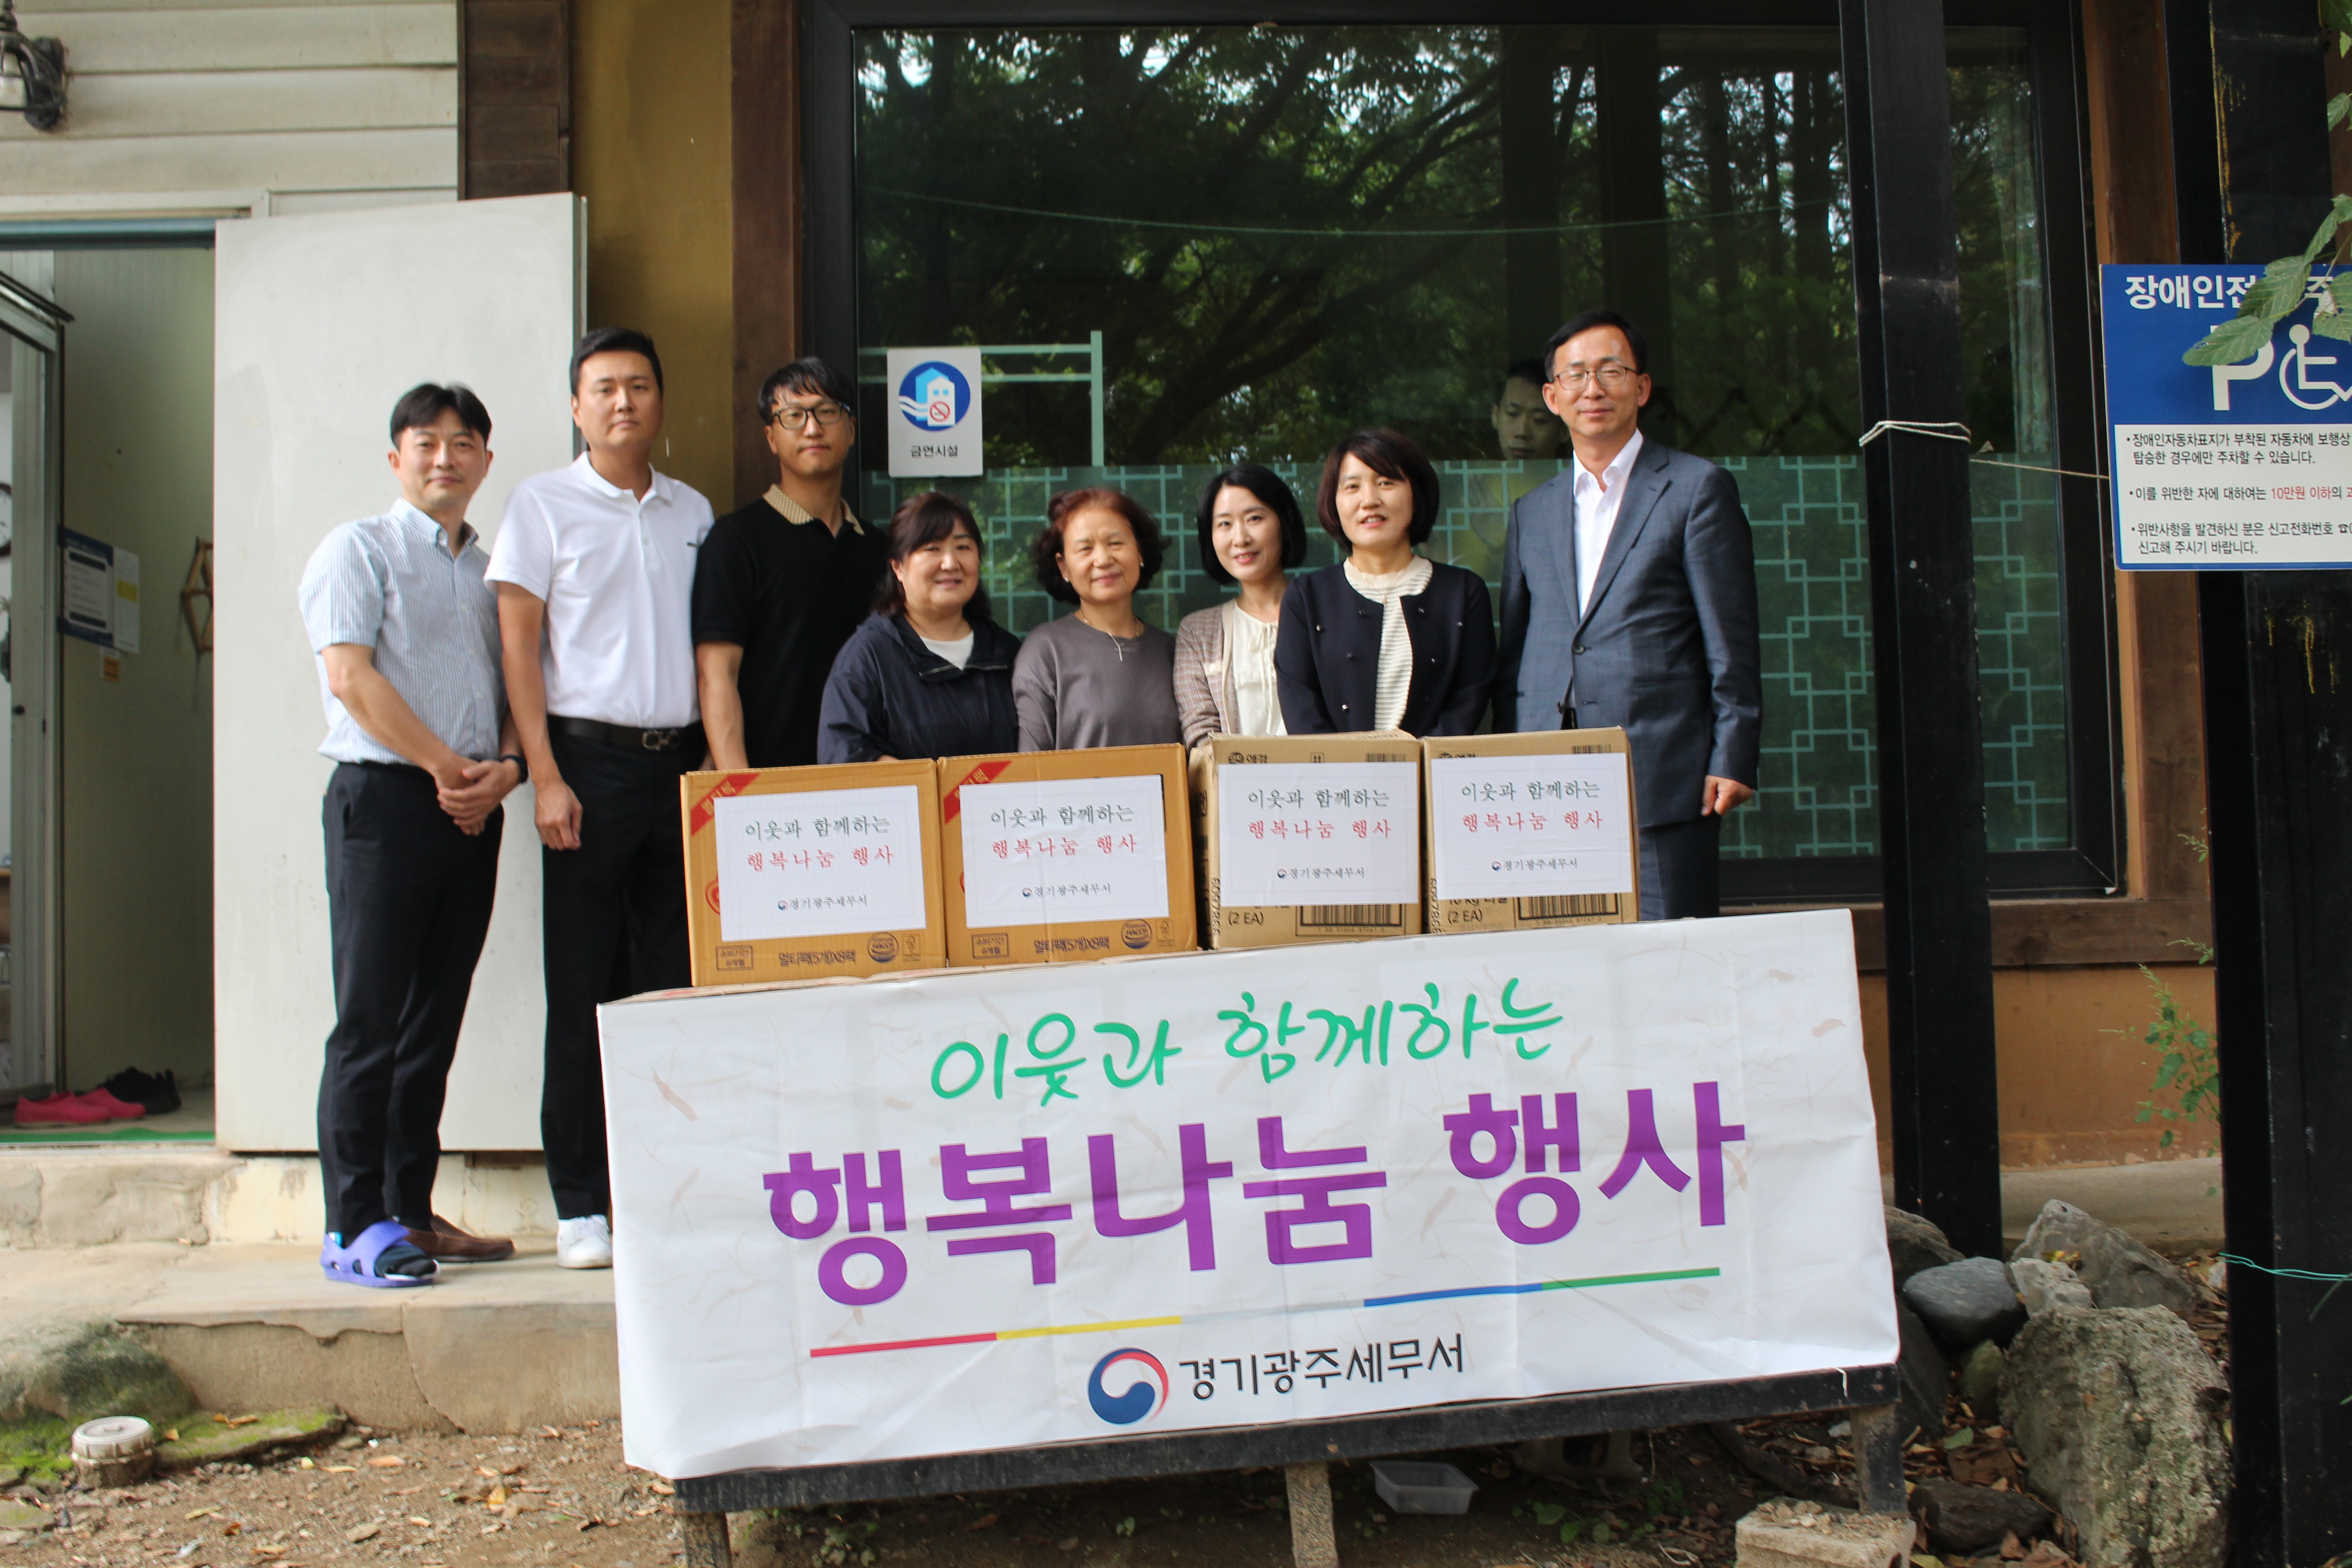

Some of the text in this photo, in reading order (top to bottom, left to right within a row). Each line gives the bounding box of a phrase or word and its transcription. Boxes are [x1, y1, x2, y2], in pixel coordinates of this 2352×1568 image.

[2132, 432, 2350, 447] 장애인자동차표지가 부착된 자동차에 보행상
[910, 445, 958, 458] 금연시설
[2133, 450, 2315, 465] 탑승한 경우에만 주차할 수 있습니다.
[2135, 487, 2156, 500] 이를
[2161, 486, 2193, 500] 위반한
[2197, 486, 2219, 500] 자에
[2223, 486, 2266, 500] 대하여는
[2271, 486, 2305, 500] 10만원
[2310, 486, 2342, 500] 이하의
[2137, 522, 2333, 536] 위반사항을 발견하신 분은 신고전화번호
[2138, 540, 2258, 554] 신고해 주시기 바랍니다.
[1248, 789, 1390, 809] 이웃과 함께하는
[1461, 780, 1601, 802] 이웃과 함께하는
[990, 804, 1135, 829] 이웃과 함께하는
[1462, 810, 1603, 833] 행복나눔 행사
[745, 815, 890, 841] 이웃과 함께하는
[1248, 819, 1392, 840] 행복나눔 행사
[991, 833, 1137, 859] 행복나눔 행사
[746, 845, 894, 873] 행복나눔 행사
[1503, 858, 1578, 872] 경기광주세무서
[1288, 867, 1365, 880] 경기광주세무서
[1034, 882, 1111, 898] 경기광주세무서
[789, 894, 868, 911] 경기광주세무서
[1228, 911, 1264, 926] (2 EA)
[1447, 908, 1483, 925] (2 EA)
[931, 978, 1563, 1107] 이웃과 함께하는
[763, 1081, 1745, 1306] 행복나눔 행사
[1179, 1332, 1465, 1401] 경기광주세무서
